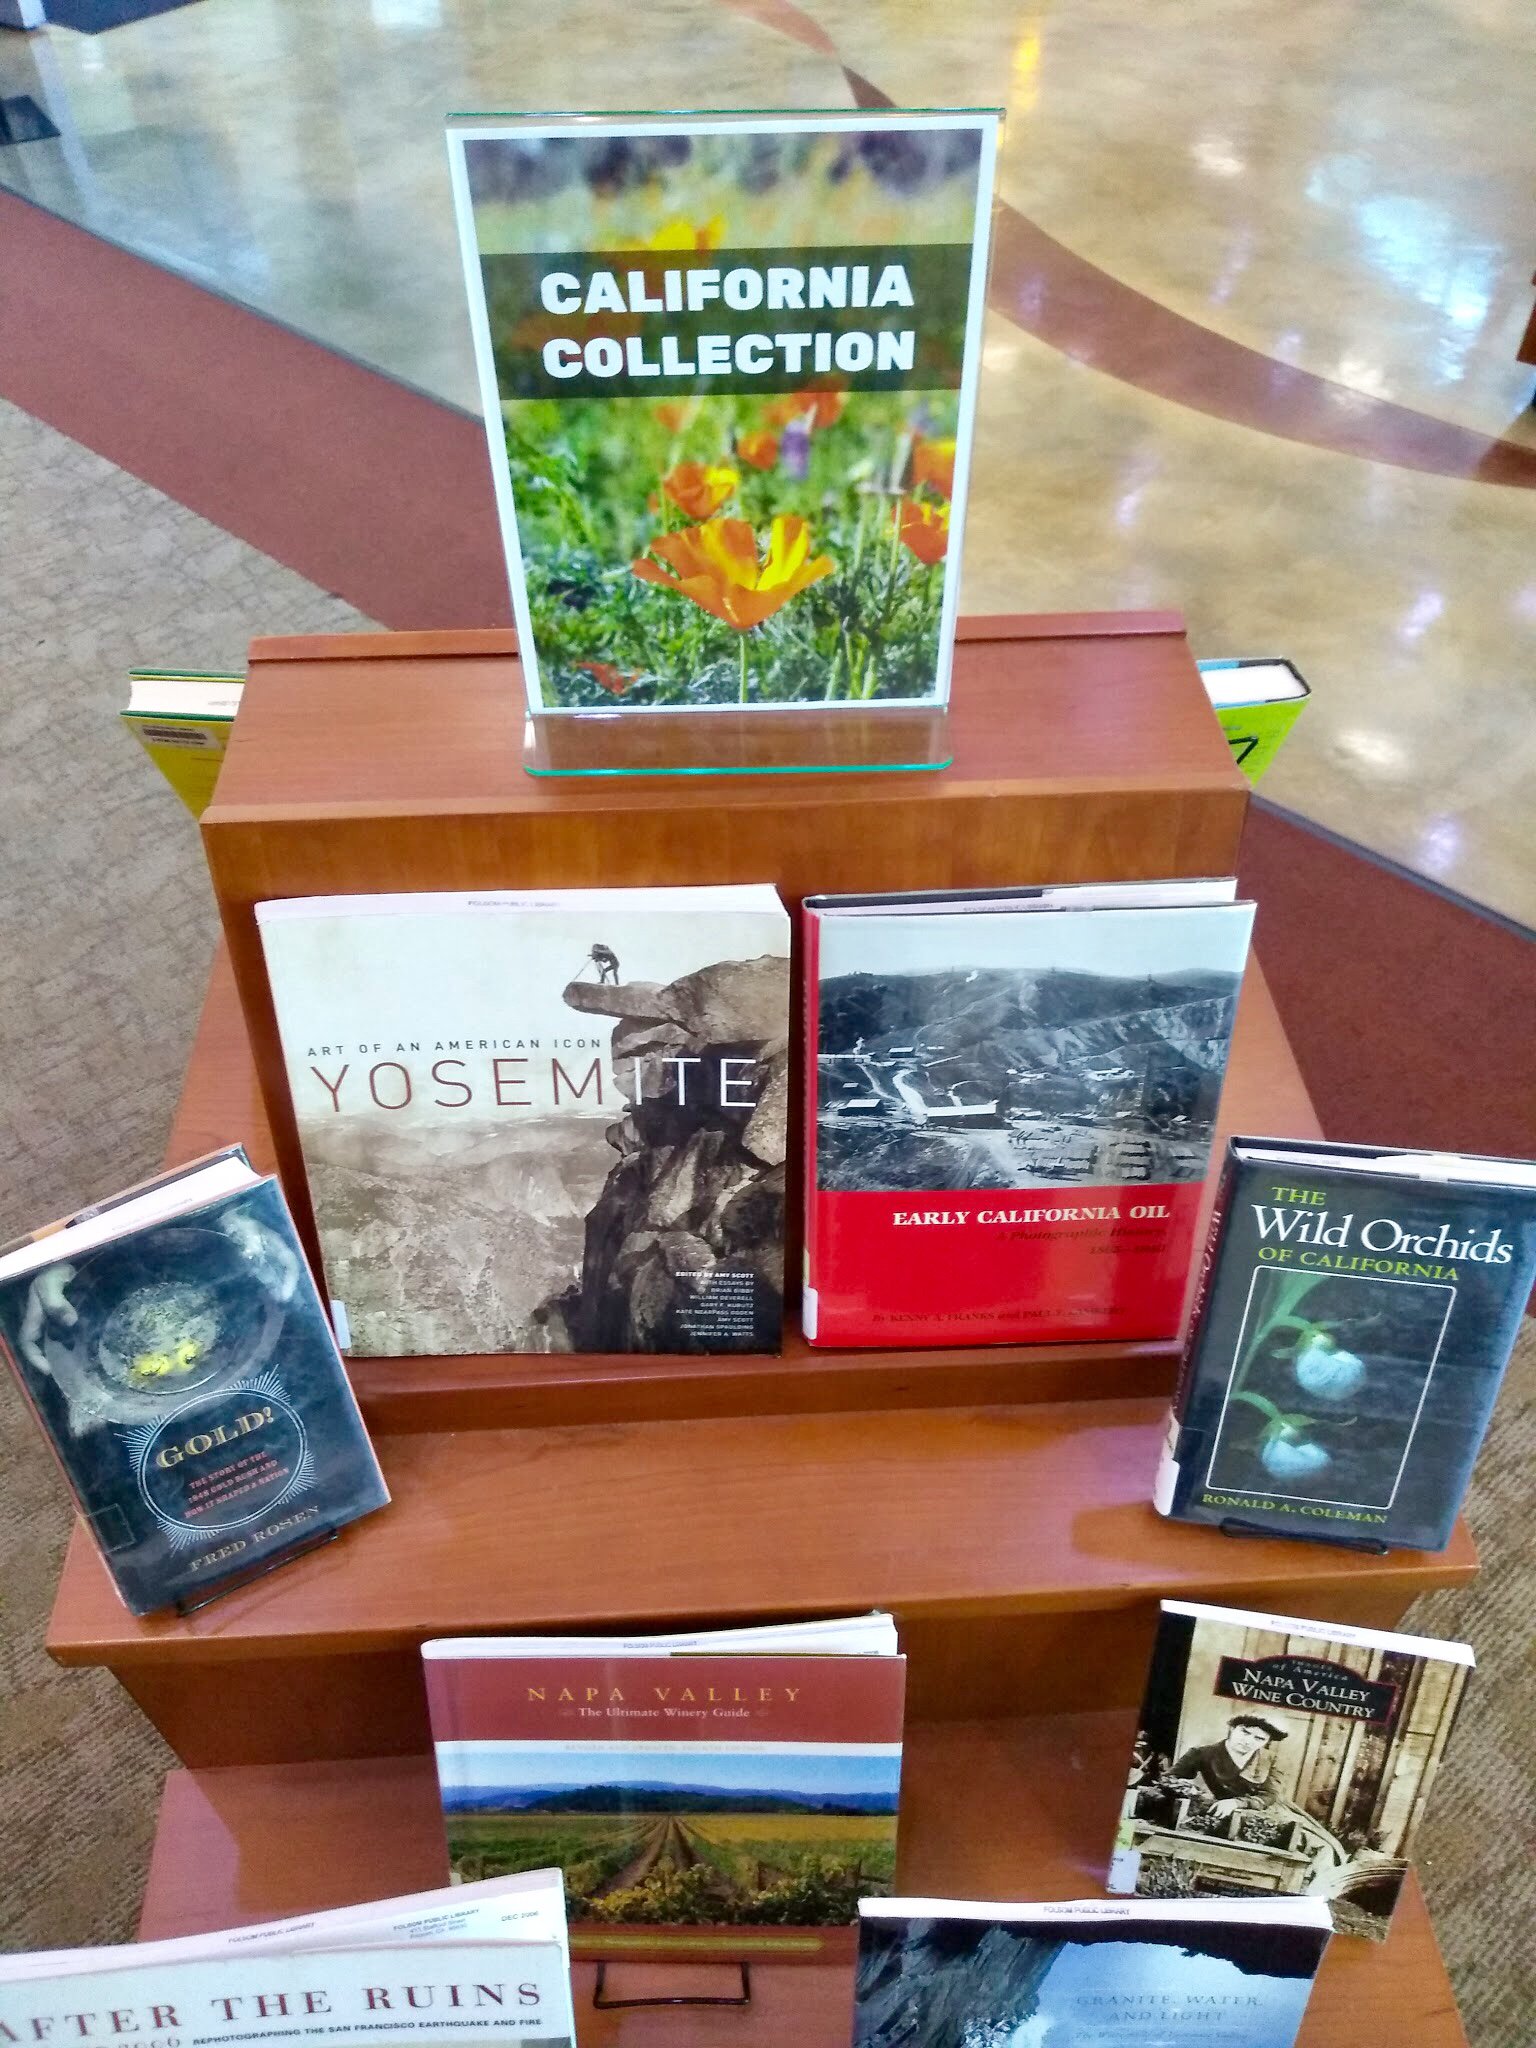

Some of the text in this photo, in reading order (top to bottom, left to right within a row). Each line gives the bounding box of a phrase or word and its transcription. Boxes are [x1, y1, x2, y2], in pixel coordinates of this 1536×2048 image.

[540, 264, 915, 315] CALIFORNIA
[541, 330, 915, 379] COLLECTION
[307, 1037, 601, 1058] ART OF AN AMERICAN ICON
[310, 1057, 758, 1113] YOSEMITE
[1271, 1186, 1327, 1206] THE
[892, 1204, 1171, 1227] EARLY CALIFORNIA OIL
[1250, 1204, 1514, 1265] Wild Orchids
[1257, 1246, 1460, 1281] OF CALIFORNIA
[155, 1406, 275, 1469] GOLD!
[1202, 1493, 1388, 1525] RONALD A. COLEMAN
[190, 1505, 319, 1572] FRED ROSEN
[527, 1687, 803, 1702] NAPA VALLEY
[1231, 1681, 1376, 1718] WINE COUNTRY
[1242, 1667, 1371, 1702] NAPA VALLEY
[578, 1707, 750, 1720] The Ultimate Winery Guide
[501, 1913, 519, 1922] DEC
[211, 1989, 332, 2022] THE
[361, 1982, 541, 2010] RUINS
[1109, 2011, 1223, 2021] AND LIGHT
[193, 2018, 542, 2046] REPHOTOGRAPHING THE SAN FRANCISCO EARTHQUAKE AND FIRE
